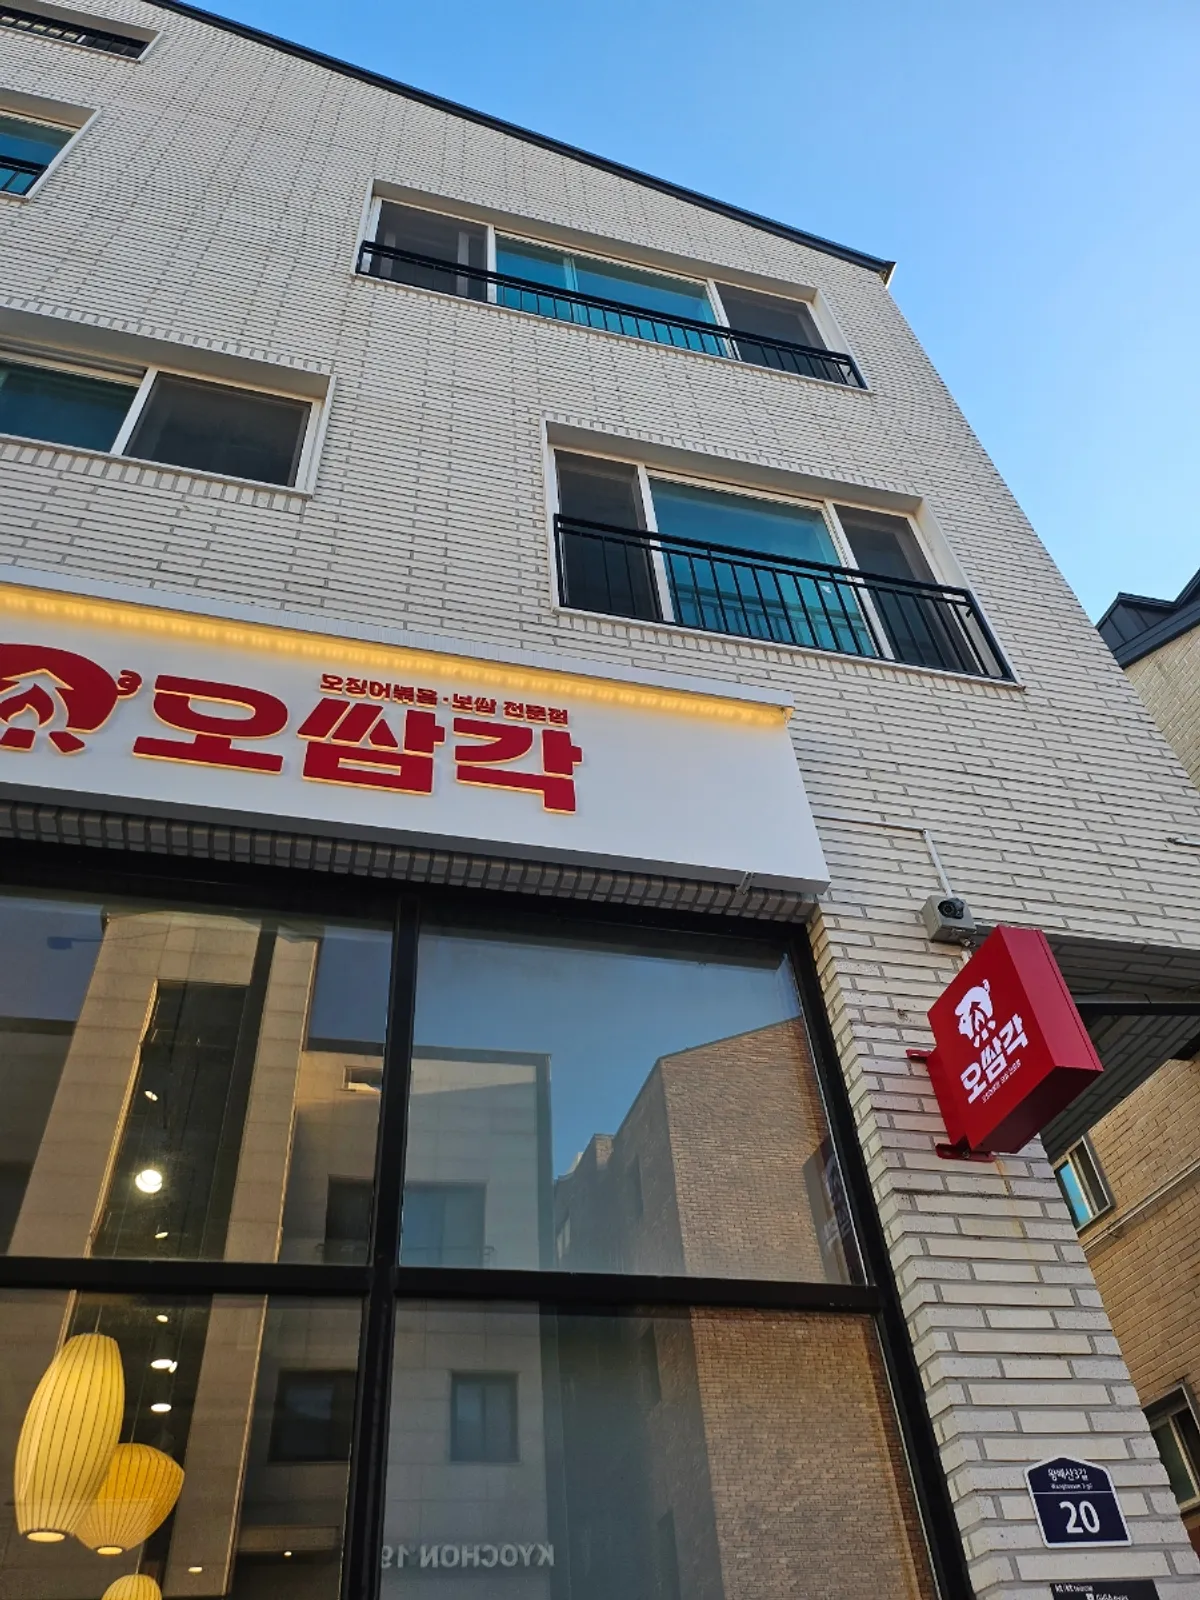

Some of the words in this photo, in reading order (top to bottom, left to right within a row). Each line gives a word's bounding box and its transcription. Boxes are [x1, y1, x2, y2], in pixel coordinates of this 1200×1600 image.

[319, 673, 438, 708] 오징어볶음
[451, 693, 497, 717] 보쌈
[503, 700, 568, 727] 전문점
[132, 673, 583, 814] 오쌈각
[960, 1013, 1028, 1104] 오쌈각
[1059, 1500, 1100, 1534] 20
